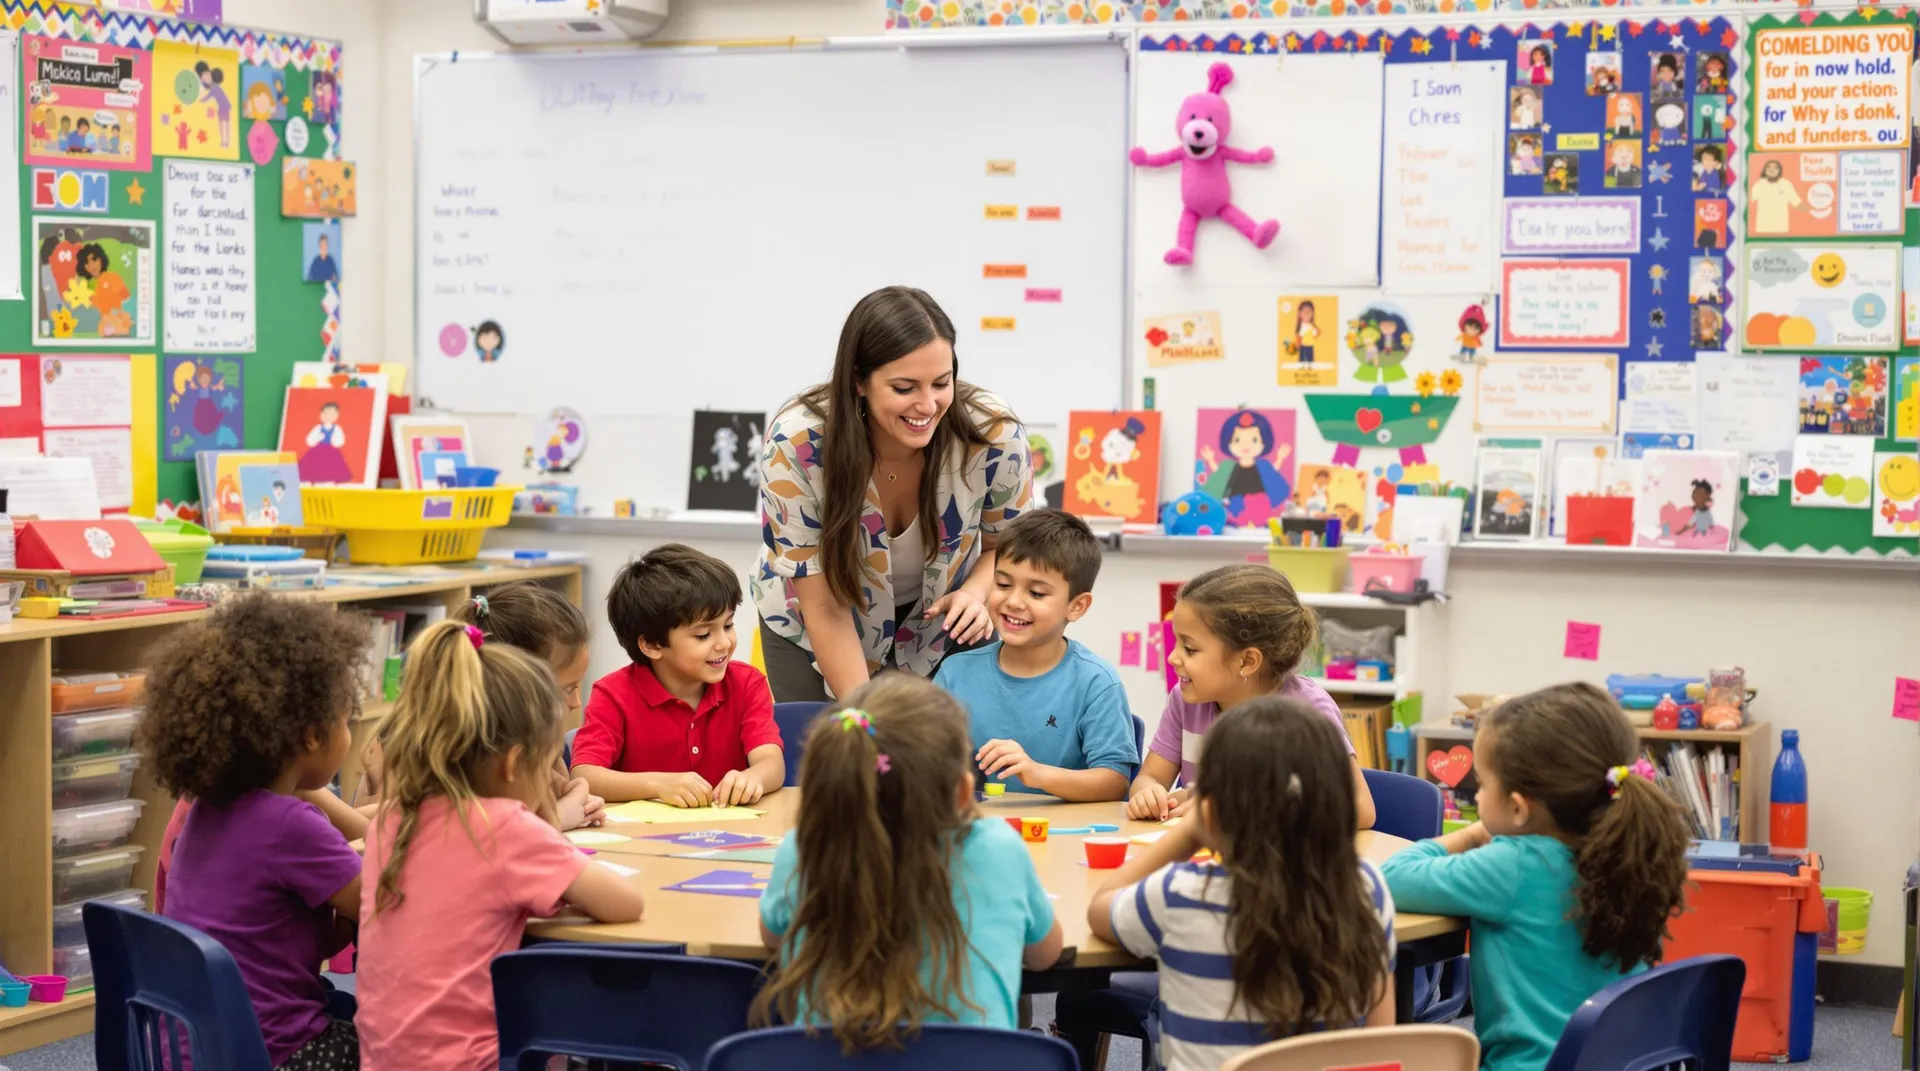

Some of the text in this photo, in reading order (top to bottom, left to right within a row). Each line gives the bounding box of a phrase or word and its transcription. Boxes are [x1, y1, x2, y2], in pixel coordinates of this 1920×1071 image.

[1760, 32, 1913, 56] COMELDING YOU
[1765, 58, 1896, 78] for in now hold.
[1767, 83, 1797, 100] and
[1801, 85, 1837, 102] your
[1764, 103, 1900, 124] for Why is donk.
[1766, 128, 1796, 144] and
[1802, 127, 1872, 144] funders.
